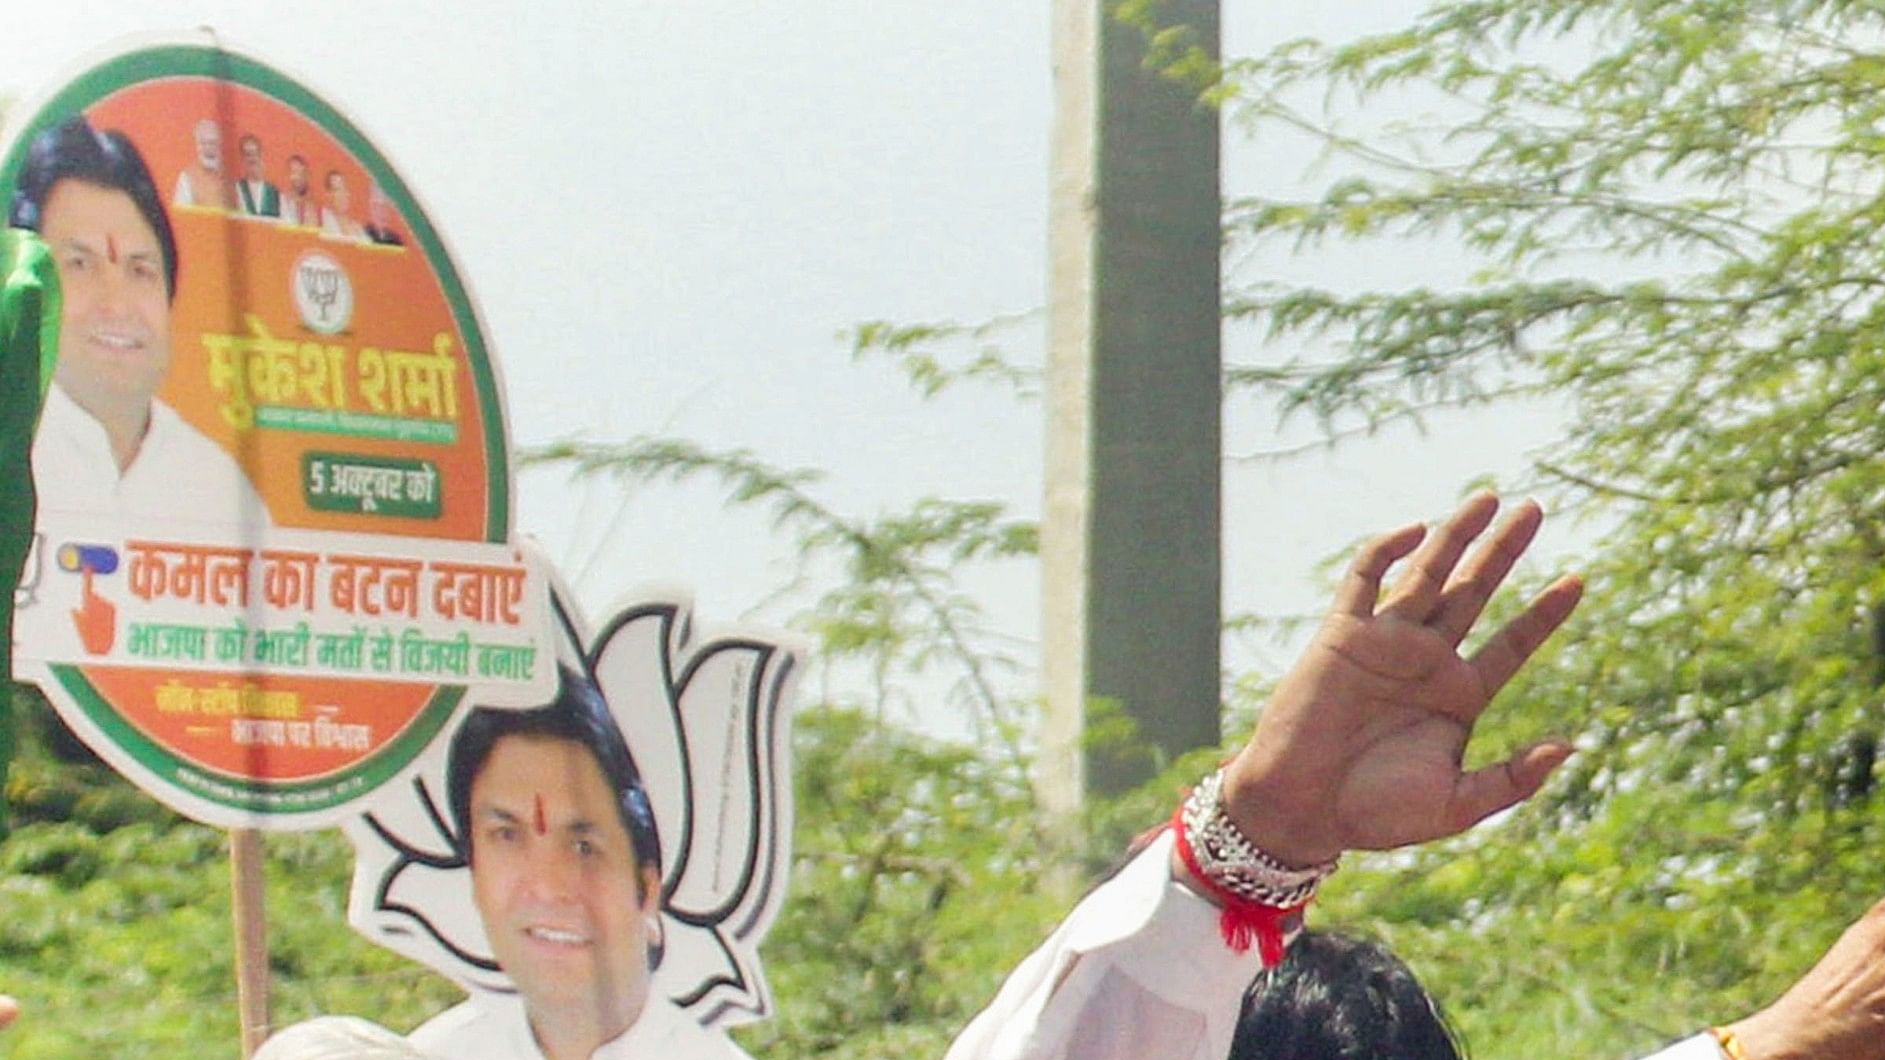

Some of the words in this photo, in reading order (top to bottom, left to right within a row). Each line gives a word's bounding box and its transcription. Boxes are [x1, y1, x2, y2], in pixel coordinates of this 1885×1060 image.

[201, 313, 346, 430] मुकेश
[357, 333, 457, 418] शर्मा
[310, 461, 325, 495] 5
[330, 464, 402, 511] अक्टूबर
[406, 462, 436, 503] को
[127, 540, 254, 609] कमल
[260, 550, 321, 612] का
[328, 554, 423, 618] बटन
[430, 551, 527, 625] दबाएं
[128, 622, 207, 661] भाजपा
[212, 617, 249, 664] को
[254, 620, 311, 667] भारी
[316, 625, 368, 671] मतों
[369, 625, 394, 671] से
[398, 626, 471, 677] विजयी
[474, 636, 537, 680] बनाएं
